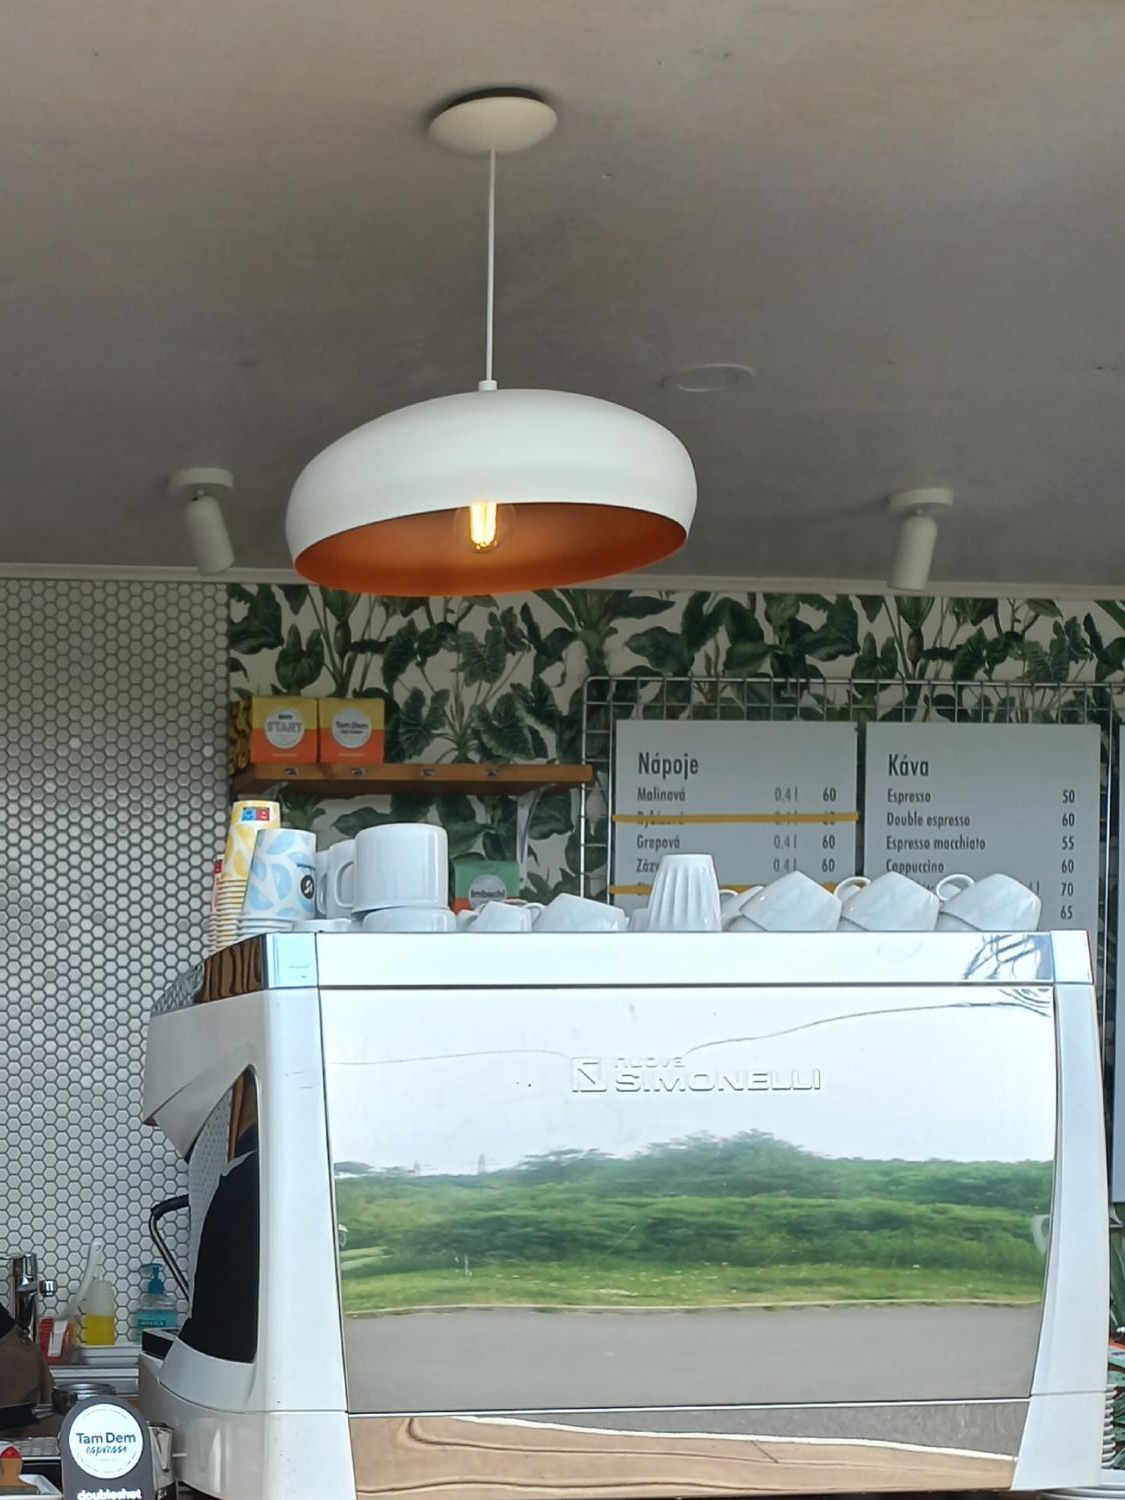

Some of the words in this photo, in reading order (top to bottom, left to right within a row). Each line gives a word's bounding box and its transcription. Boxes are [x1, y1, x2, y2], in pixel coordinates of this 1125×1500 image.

[638, 752, 699, 780] Nápoje
[888, 754, 929, 777] Káva
[637, 786, 686, 801] Malinová
[822, 787, 836, 801] 60
[887, 788, 931, 805] Espresso
[1062, 789, 1075, 803] 50
[887, 811, 923, 826] Double
[926, 814, 971, 829] espresso
[1061, 813, 1075, 827] 60
[636, 834, 680, 851] Grepová
[822, 834, 836, 849] 60
[886, 835, 930, 852] Espresso
[933, 834, 986, 850] macchiato
[1061, 836, 1075, 850] 55
[821, 858, 835, 872] 60
[886, 859, 944, 876] Cappuccino
[1061, 859, 1075, 873] 60
[1060, 882, 1074, 897] 70
[1060, 905, 1073, 920] 65
[615, 1069, 821, 1092] SIMONELLI
[75, 1432, 104, 1445] Tam
[105, 1432, 137, 1444] Dem
[85, 1445, 128, 1457] espresso
